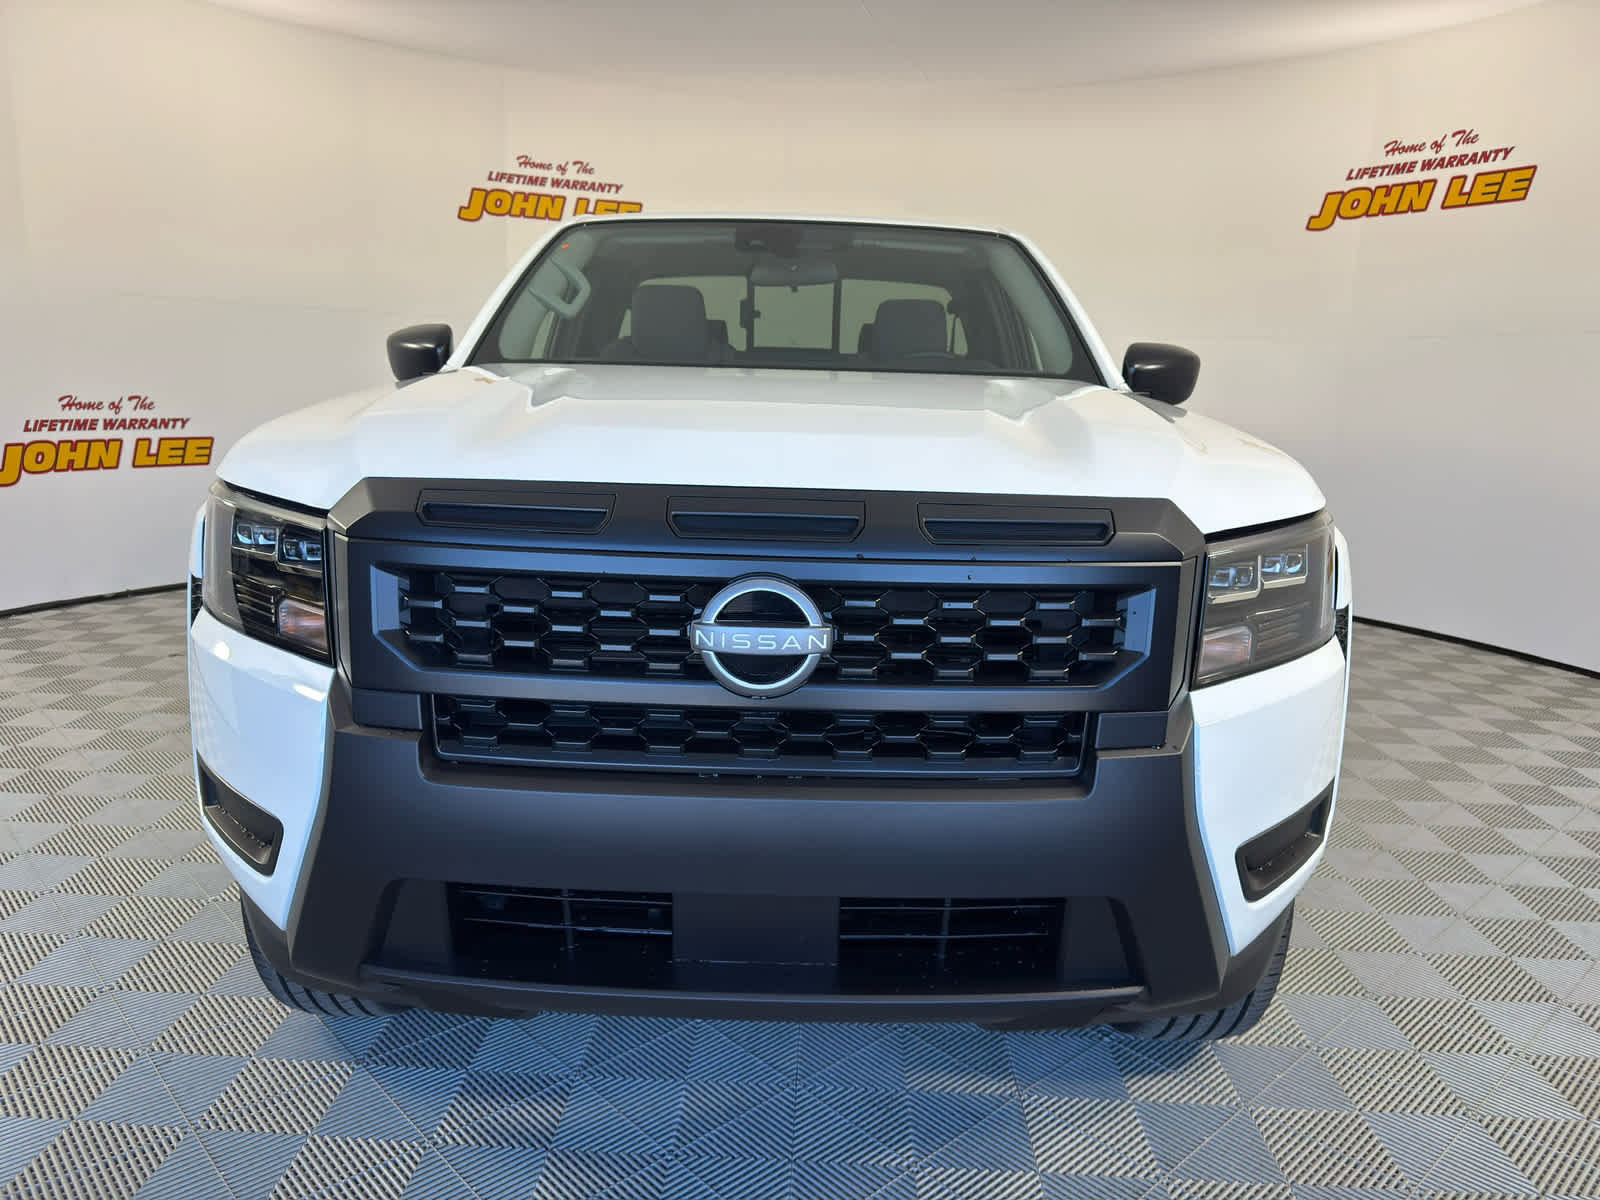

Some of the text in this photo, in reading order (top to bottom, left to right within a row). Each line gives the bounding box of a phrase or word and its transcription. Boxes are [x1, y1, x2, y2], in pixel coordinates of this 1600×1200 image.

[1384, 129, 1480, 157] Home of The
[516, 155, 595, 175] Home of The
[1345, 146, 1516, 181] LIFETIME WARRANTY
[487, 171, 623, 194] LIFETIME WARRANTY
[457, 187, 566, 222] JOHN
[1305, 164, 1538, 231] JOHN LEE
[58, 395, 155, 415] Home of The
[23, 418, 190, 433] LIFETIME WARRANTY
[0, 436, 215, 488] JOHN LEE
[694, 630, 828, 651] NISSAN
